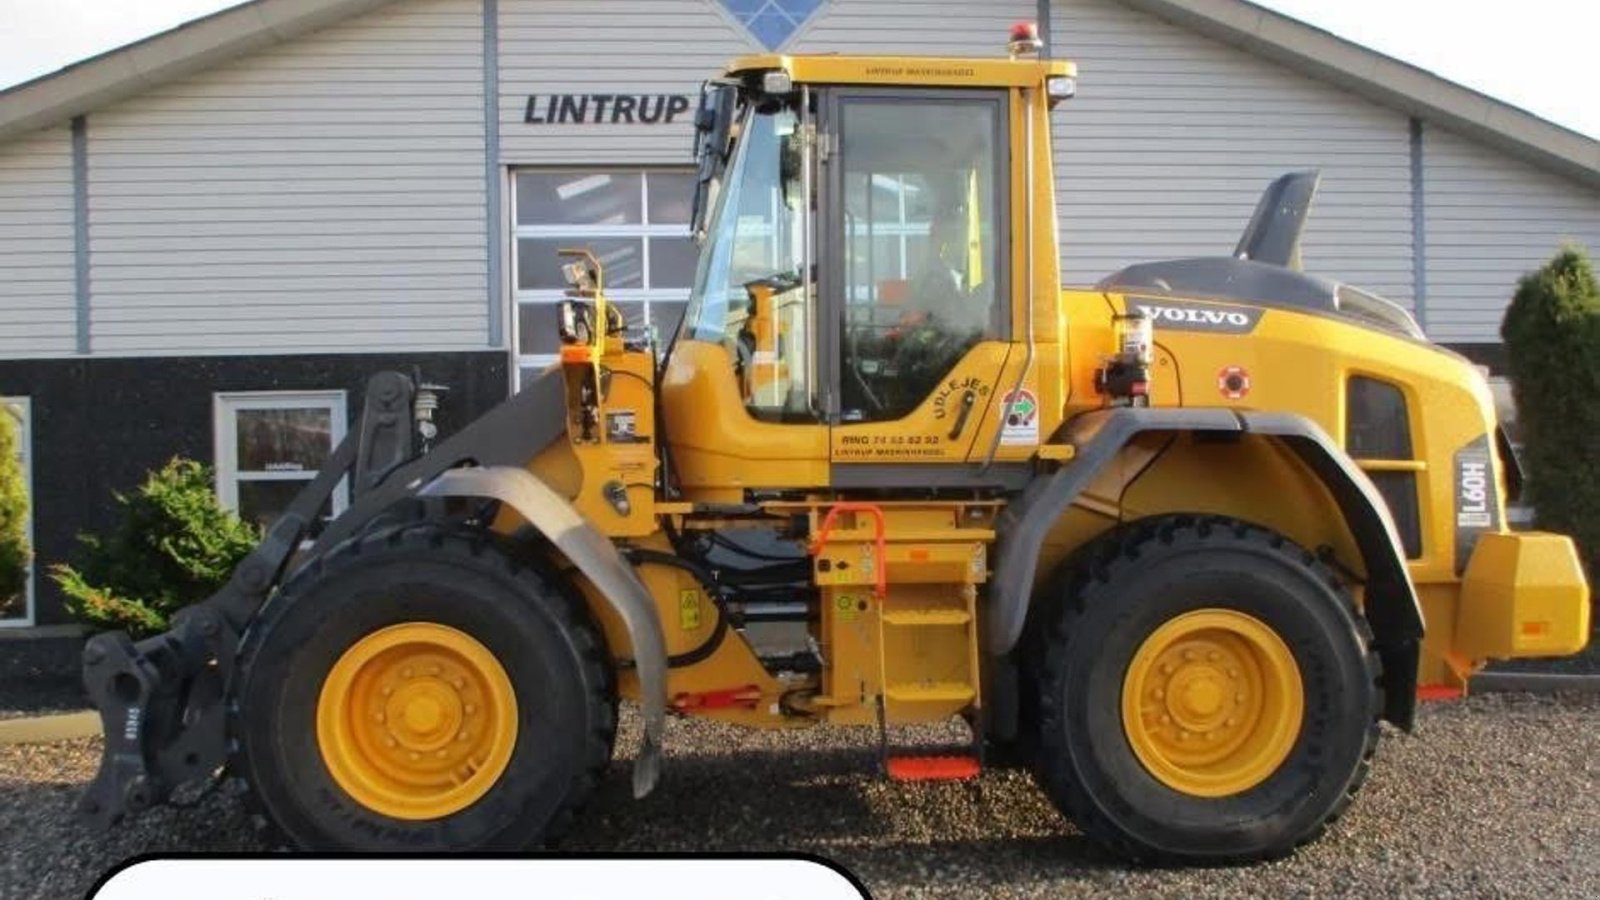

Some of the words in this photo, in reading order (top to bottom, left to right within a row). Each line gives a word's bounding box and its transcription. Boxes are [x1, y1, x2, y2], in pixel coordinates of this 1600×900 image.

[524, 94, 690, 124] LINTRUP
[1136, 304, 1250, 326] VOLVO
[841, 435, 870, 446] RING
[1461, 463, 1487, 513] L60H
